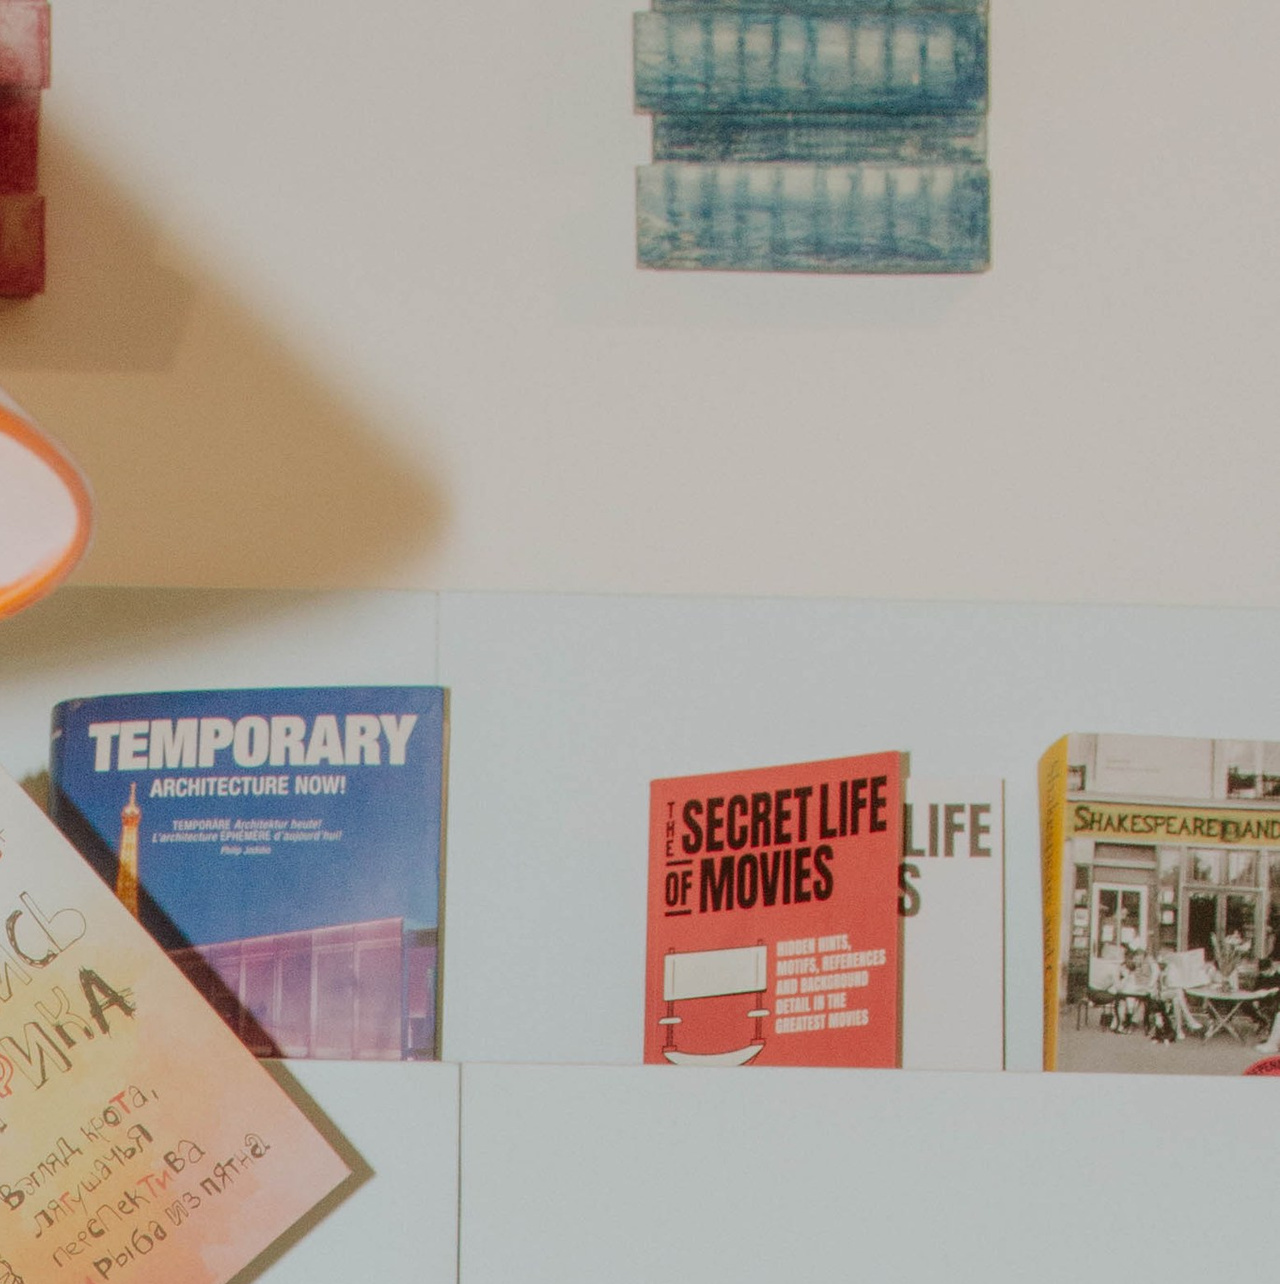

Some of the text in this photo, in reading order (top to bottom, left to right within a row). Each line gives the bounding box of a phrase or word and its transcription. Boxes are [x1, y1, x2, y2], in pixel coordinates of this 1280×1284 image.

[87, 713, 418, 772] TEMPORARY
[149, 775, 347, 798] ARCHITECTURE NOW!
[681, 775, 888, 855] SECRET LIFE
[903, 802, 992, 858] LIFE
[1073, 804, 1220, 836] SHAKESPEARE
[665, 869, 693, 906] OF
[698, 844, 835, 914] MOVIES
[776, 936, 816, 957] HIDDEN
[776, 949, 887, 976] MOTIFS, REFERENCES
[775, 993, 847, 1015] DETAIL IN THE
[776, 970, 869, 996] AND BACKGROUND
[775, 1009, 869, 1035] GREATEST MOVIES
[34, 1123, 154, 1240] лягушачья
[164, 1191, 202, 1227] из
[199, 1132, 272, 1198] пятна
[52, 1138, 206, 1268] перспектива
